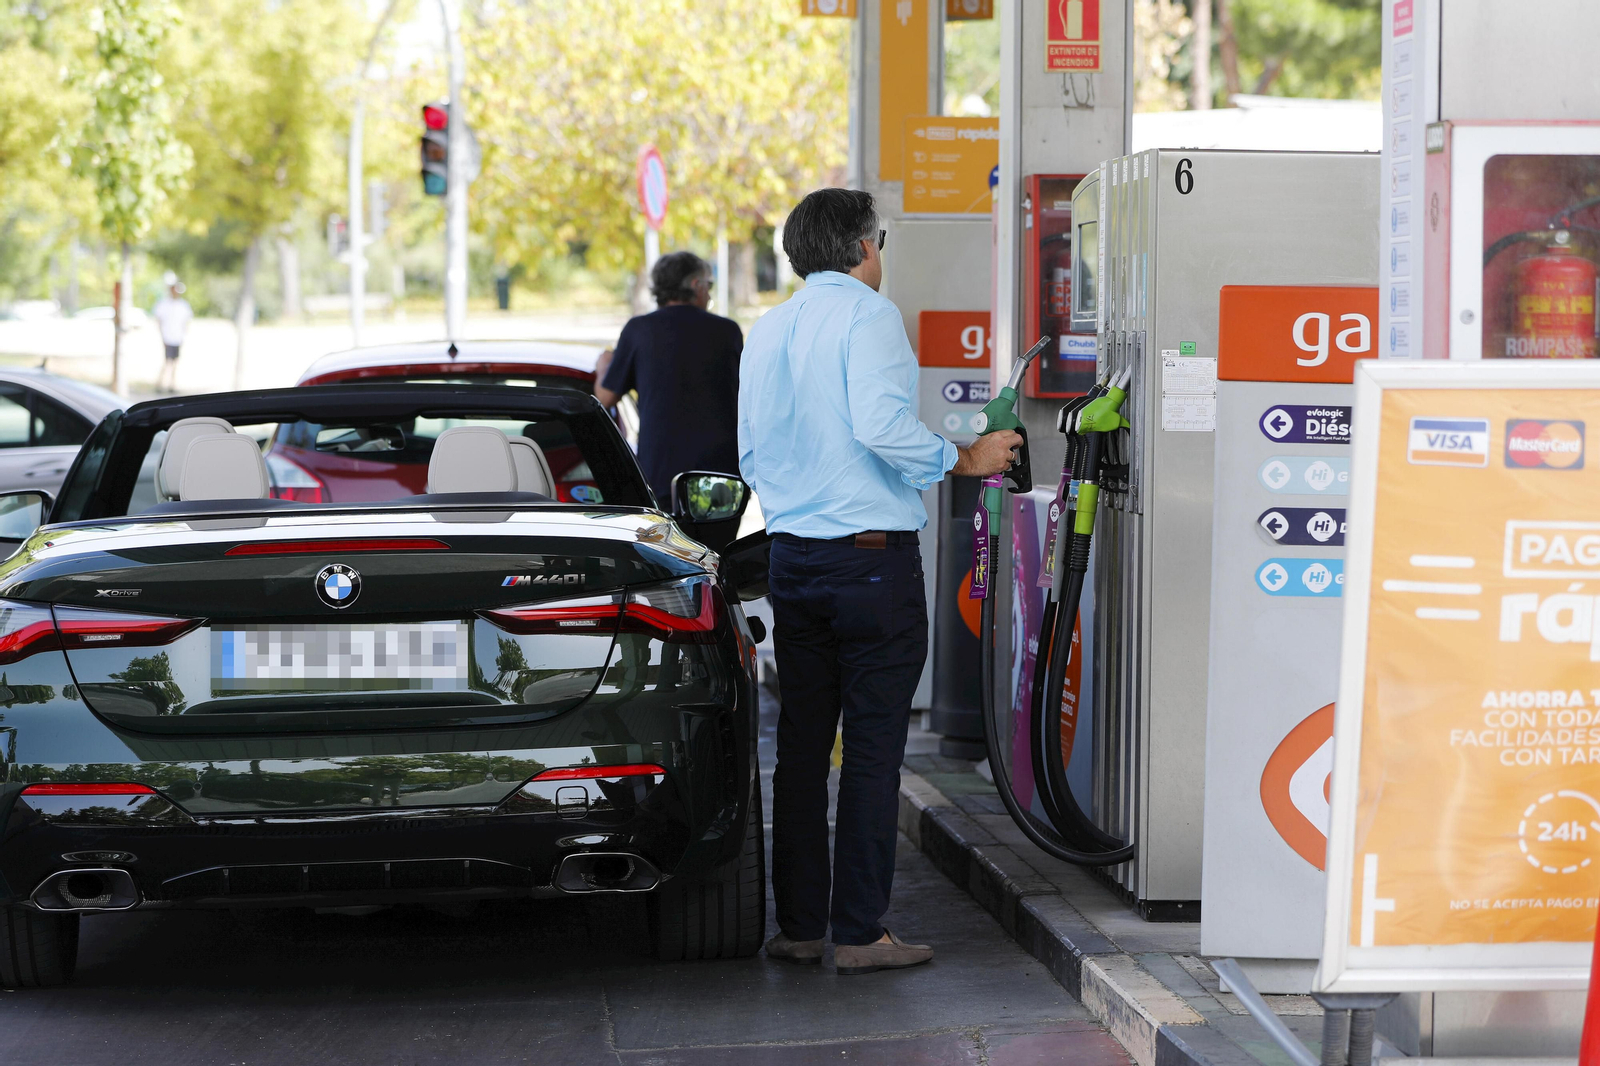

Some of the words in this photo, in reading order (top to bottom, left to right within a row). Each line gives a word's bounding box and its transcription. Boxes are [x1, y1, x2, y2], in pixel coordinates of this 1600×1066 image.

[1050, 47, 1086, 55] EXTINTOR
[1088, 47, 1097, 55] DE
[1053, 58, 1094, 66] INCENDIOS
[1174, 158, 1195, 195] 6
[961, 325, 991, 360] g
[1068, 340, 1096, 348] Chubb
[1292, 311, 1371, 366] ga
[1306, 408, 1344, 419] evologic
[1305, 418, 1354, 436] Diés
[1426, 433, 1473, 450] VISA
[1508, 437, 1580, 454] MasterCard
[1311, 469, 1328, 481] Hi
[1313, 520, 1330, 532] Hi
[320, 565, 357, 580] BMW
[516, 573, 586, 586] M440i
[1309, 570, 1325, 582] Hi
[1481, 690, 1585, 709] AHORRA
[1484, 711, 1537, 728] CON
[1499, 748, 1551, 766] CON
[1537, 820, 1587, 842] 24h
[1450, 900, 1471, 910] NO
[1473, 899, 1490, 909] SE
[1492, 898, 1543, 910] ACEPTA
[1546, 897, 1584, 909] PAGO
